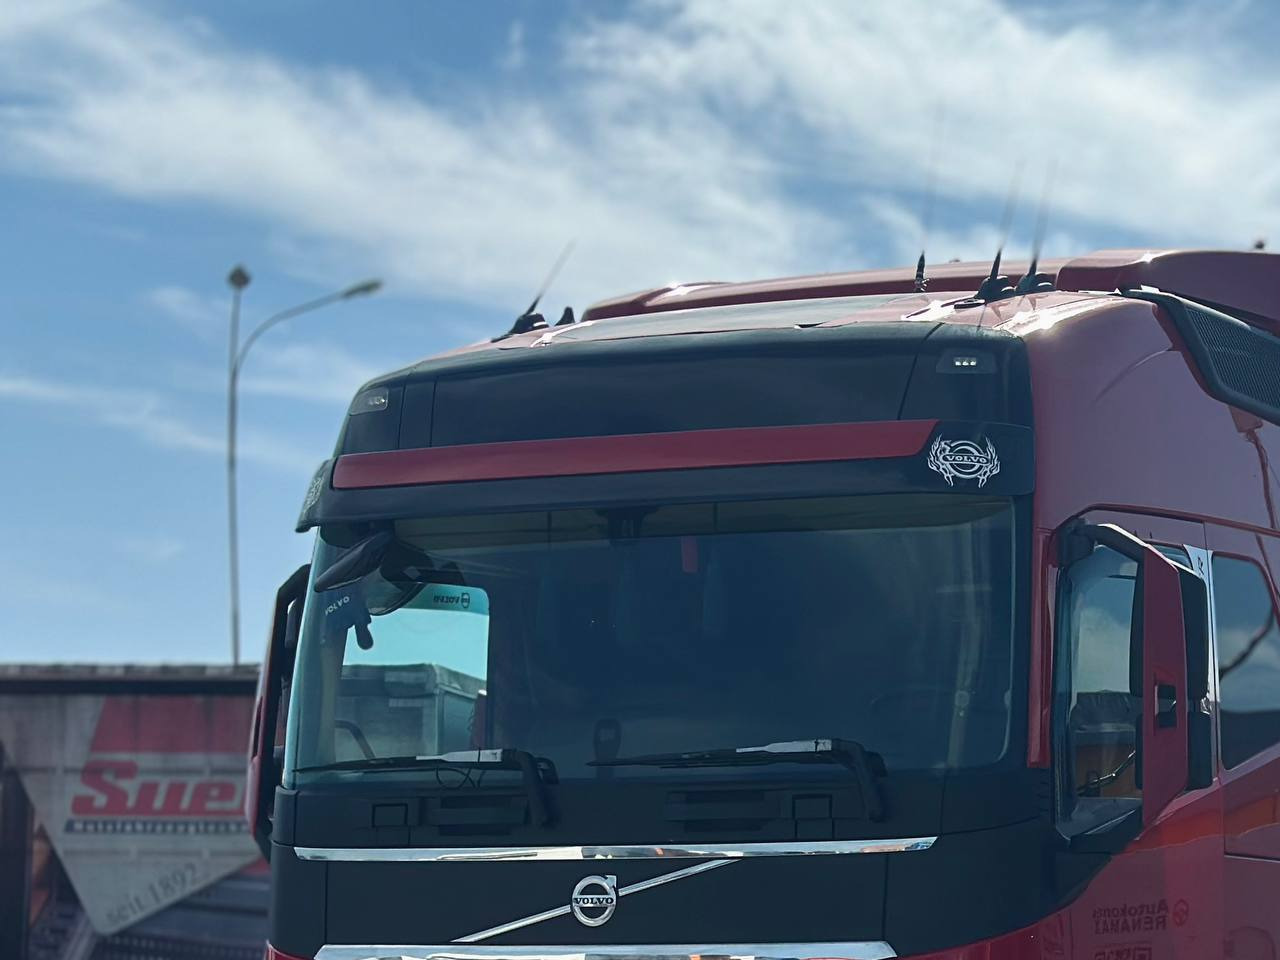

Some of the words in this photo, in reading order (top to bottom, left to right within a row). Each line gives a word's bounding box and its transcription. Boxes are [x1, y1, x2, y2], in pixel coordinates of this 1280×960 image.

[945, 455, 988, 464] VOLVO
[71, 760, 248, 817] Sue
[574, 897, 615, 905] VOLVO
